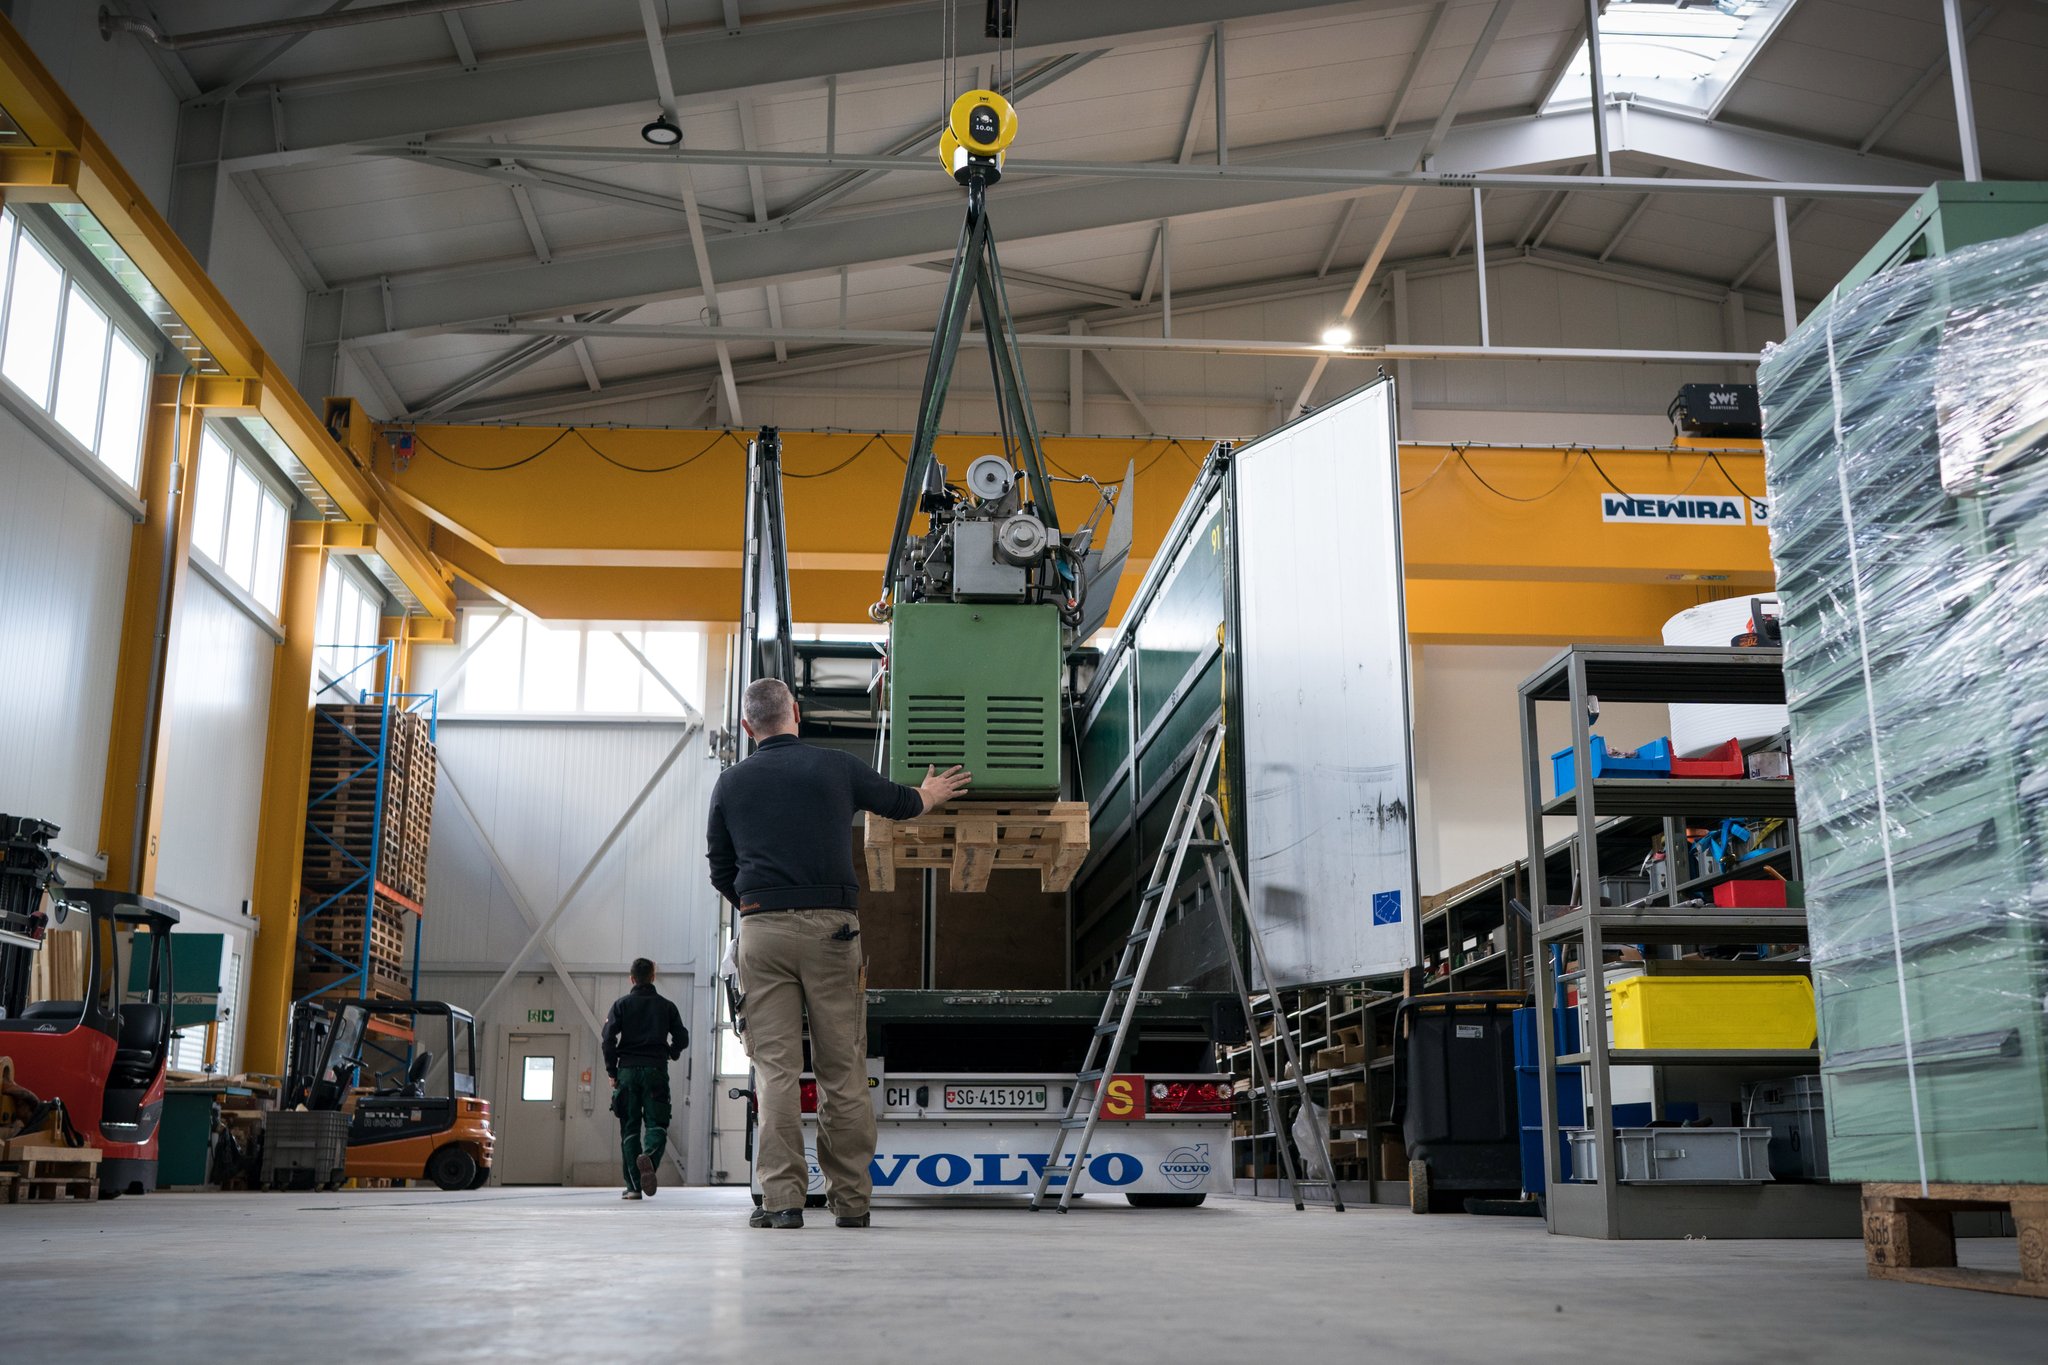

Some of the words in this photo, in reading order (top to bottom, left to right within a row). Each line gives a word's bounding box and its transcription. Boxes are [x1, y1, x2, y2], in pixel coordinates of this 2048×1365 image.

[1709, 392, 1738, 405] SWF
[1605, 499, 1741, 519] WEWIRA
[886, 1088, 910, 1106] CH
[1106, 1080, 1134, 1115] S
[868, 1152, 1144, 1187] VOLVO
[1163, 1164, 1209, 1173] VOLVO
